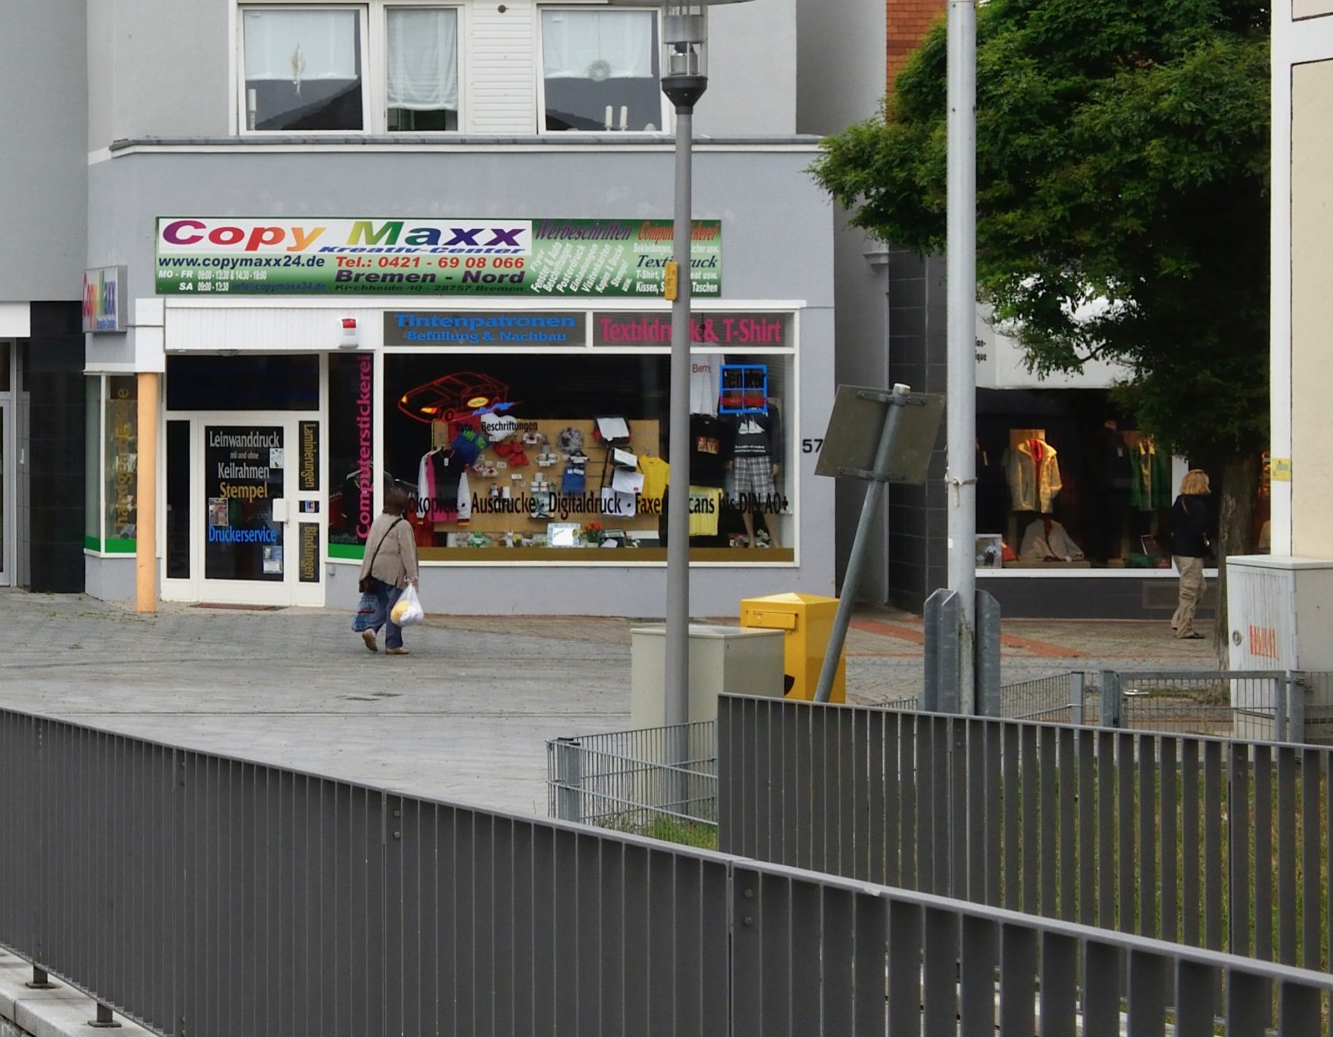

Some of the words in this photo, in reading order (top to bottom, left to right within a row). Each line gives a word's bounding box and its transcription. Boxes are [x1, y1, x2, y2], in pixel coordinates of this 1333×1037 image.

[162, 220, 326, 252] Copy
[346, 221, 526, 246] Maxx
[318, 246, 526, 254] Kreativ-Center
[158, 255, 325, 270] www.copymaxx24.de
[336, 256, 372, 268] Tel.:
[378, 256, 421, 268] 0421
[438, 256, 460, 268] 69
[465, 257, 487, 268] 08
[492, 257, 525, 268] 066
[556, 244, 586, 293] Posterdruck
[569, 244, 598, 292] Einladungen
[581, 244, 611, 292] Visitenkarten
[637, 254, 719, 268] Textuck
[158, 270, 173, 279] MO
[180, 270, 194, 279] FR
[335, 270, 436, 283] Bremen
[462, 271, 525, 284] Nord
[179, 282, 193, 291] SA
[636, 281, 659, 295] Kissen,
[692, 281, 718, 293] Taschen
[394, 314, 576, 331] Tintenpatronen
[600, 318, 701, 342] Textildrk
[703, 318, 720, 342] &
[723, 318, 782, 342] T-Shirt
[407, 331, 480, 344] Befüllung
[483, 331, 495, 341] &
[500, 331, 567, 341] Nachbau
[481, 420, 538, 435] Beschriftungen
[209, 430, 280, 448] Leinwanddruck
[356, 354, 373, 540] Computerstickerei
[802, 439, 823, 453] 57
[230, 451, 238, 460] mit
[238, 451, 247, 460] und
[248, 451, 259, 460] ohne
[300, 423, 316, 488] Laminierungen
[218, 462, 270, 479] Keilrahmen
[219, 481, 268, 503] Stempel
[471, 491, 537, 514] Ausdrucke
[548, 491, 622, 520] Digitaldruck
[635, 493, 664, 514] Faxe
[689, 497, 715, 514] cans
[209, 525, 277, 543] Druckerservice
[302, 526, 317, 579] Bindungen
